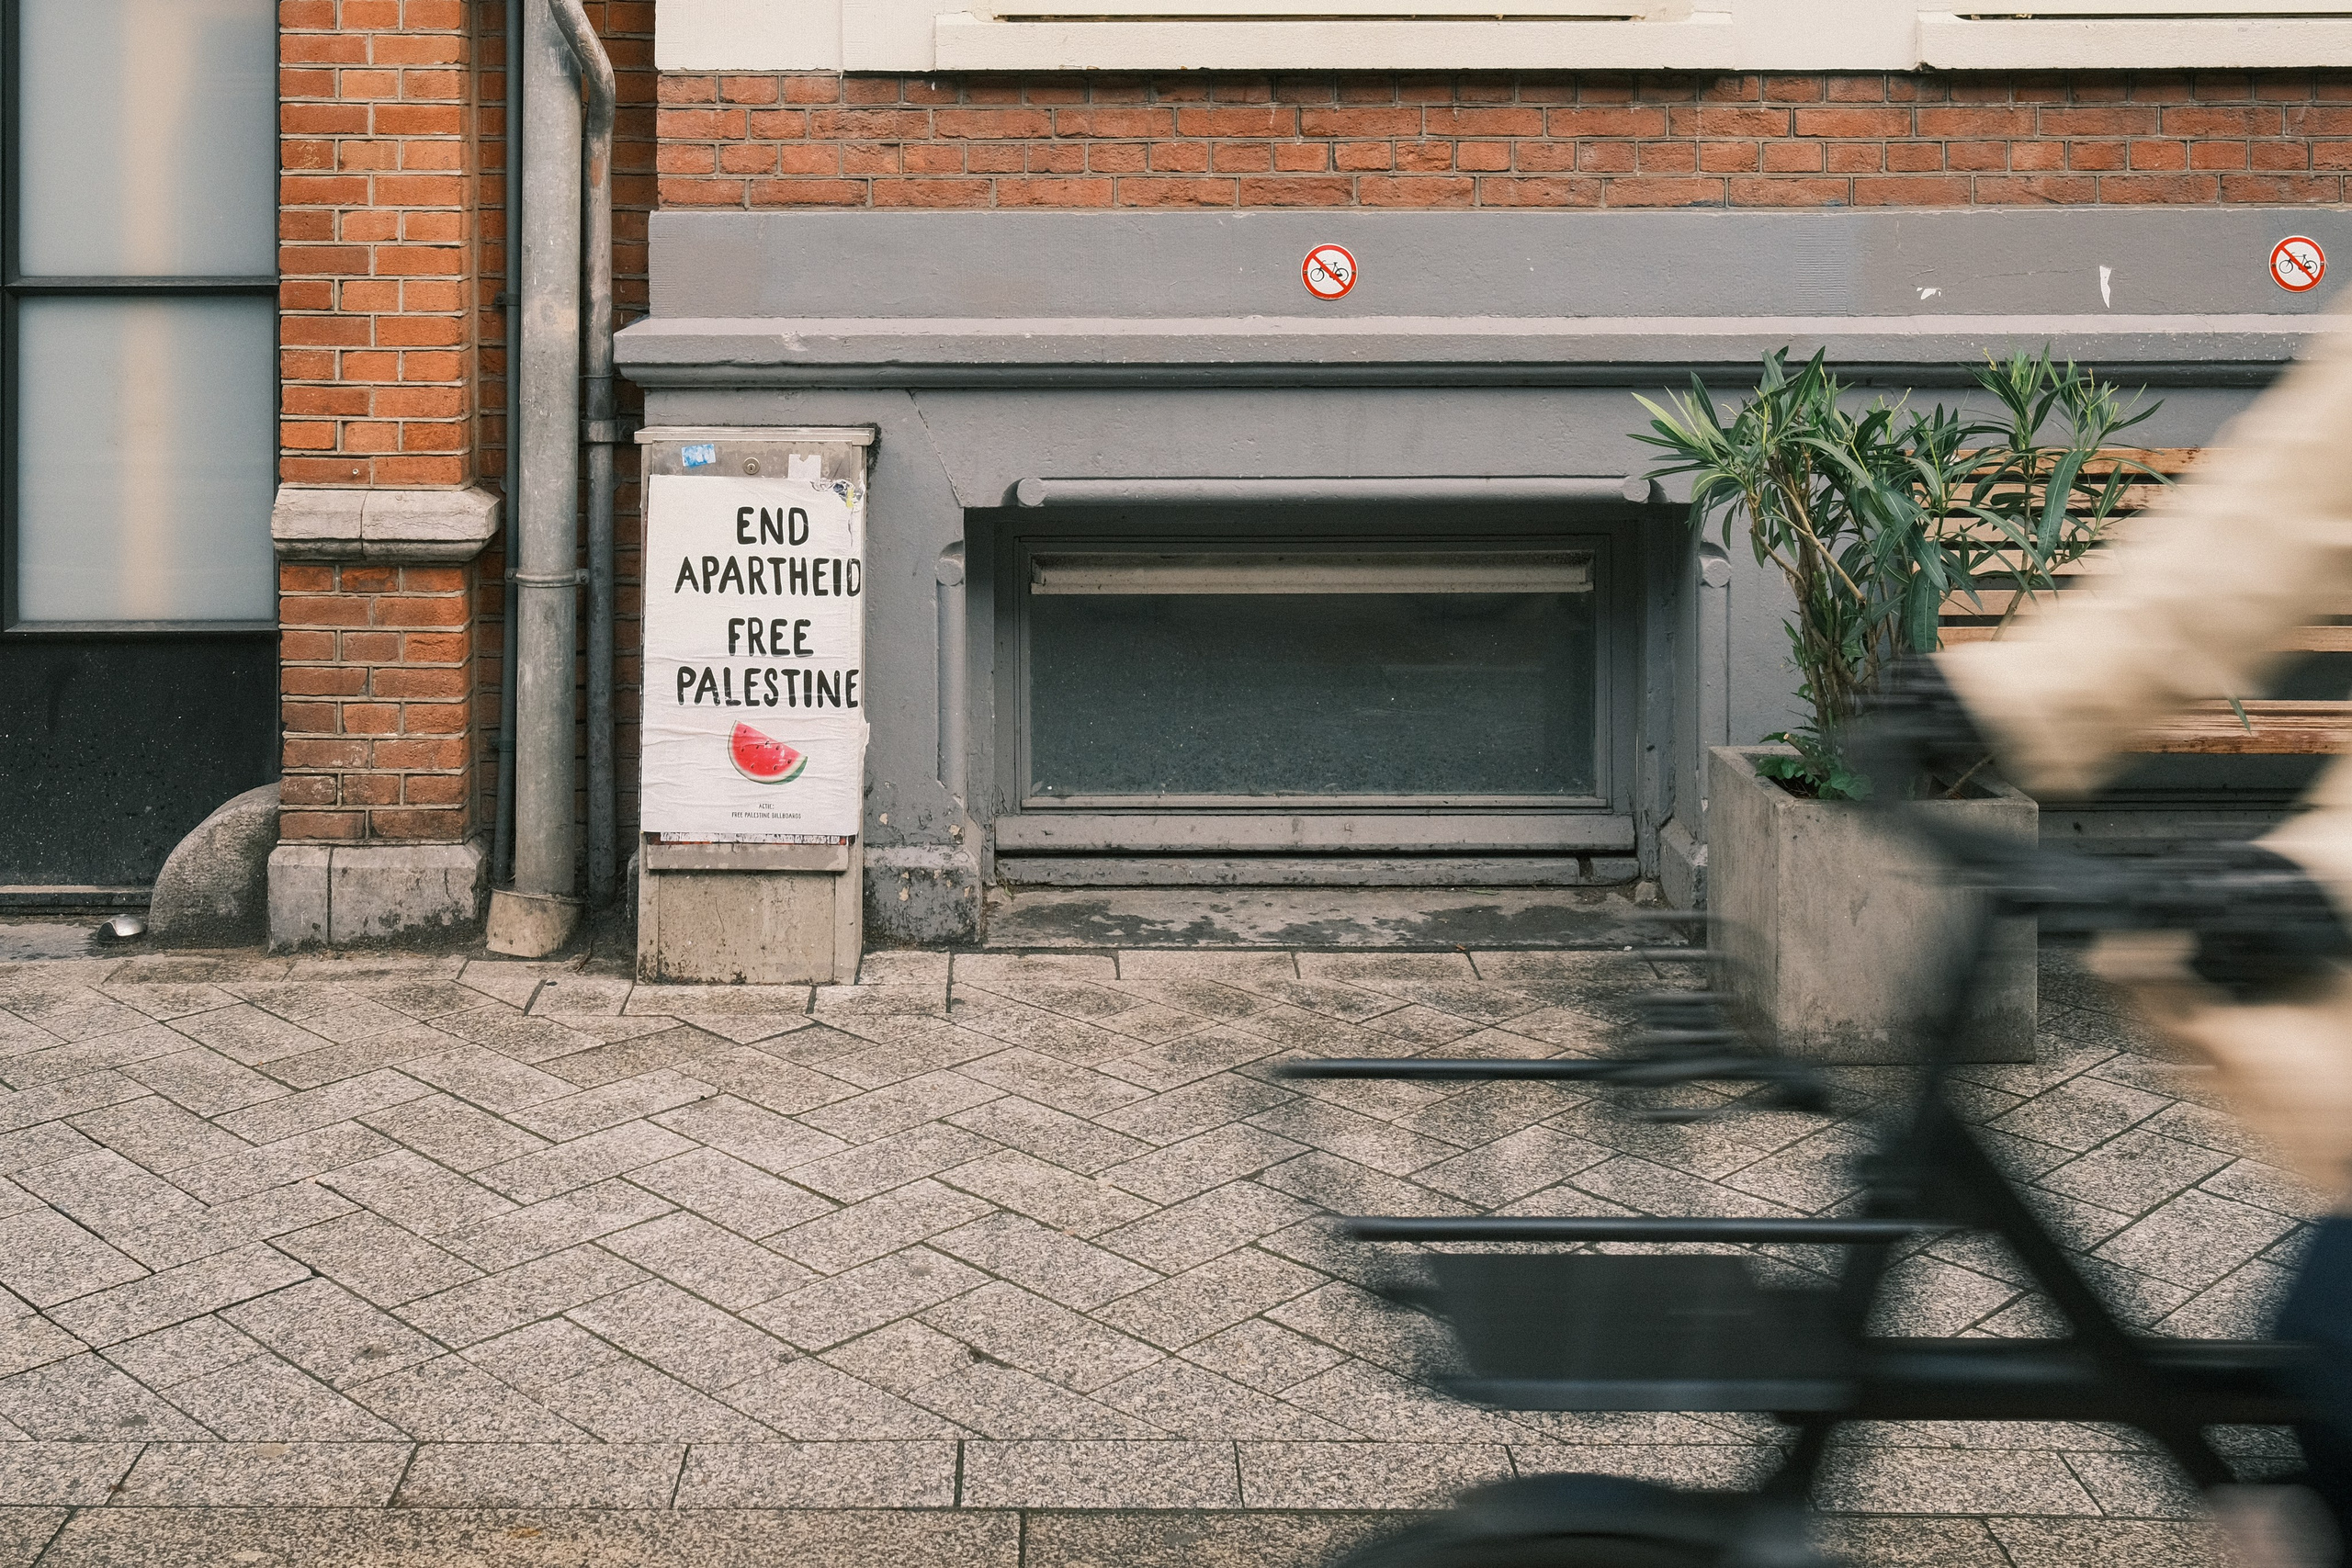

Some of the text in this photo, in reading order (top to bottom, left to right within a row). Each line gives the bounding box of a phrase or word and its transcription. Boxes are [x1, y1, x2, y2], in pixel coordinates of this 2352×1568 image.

[736, 506, 809, 547] END
[674, 555, 861, 597] APARTHEID
[728, 616, 814, 658] FREE
[676, 666, 859, 709] PALESTINE
[744, 811, 771, 819] PALESTINE
